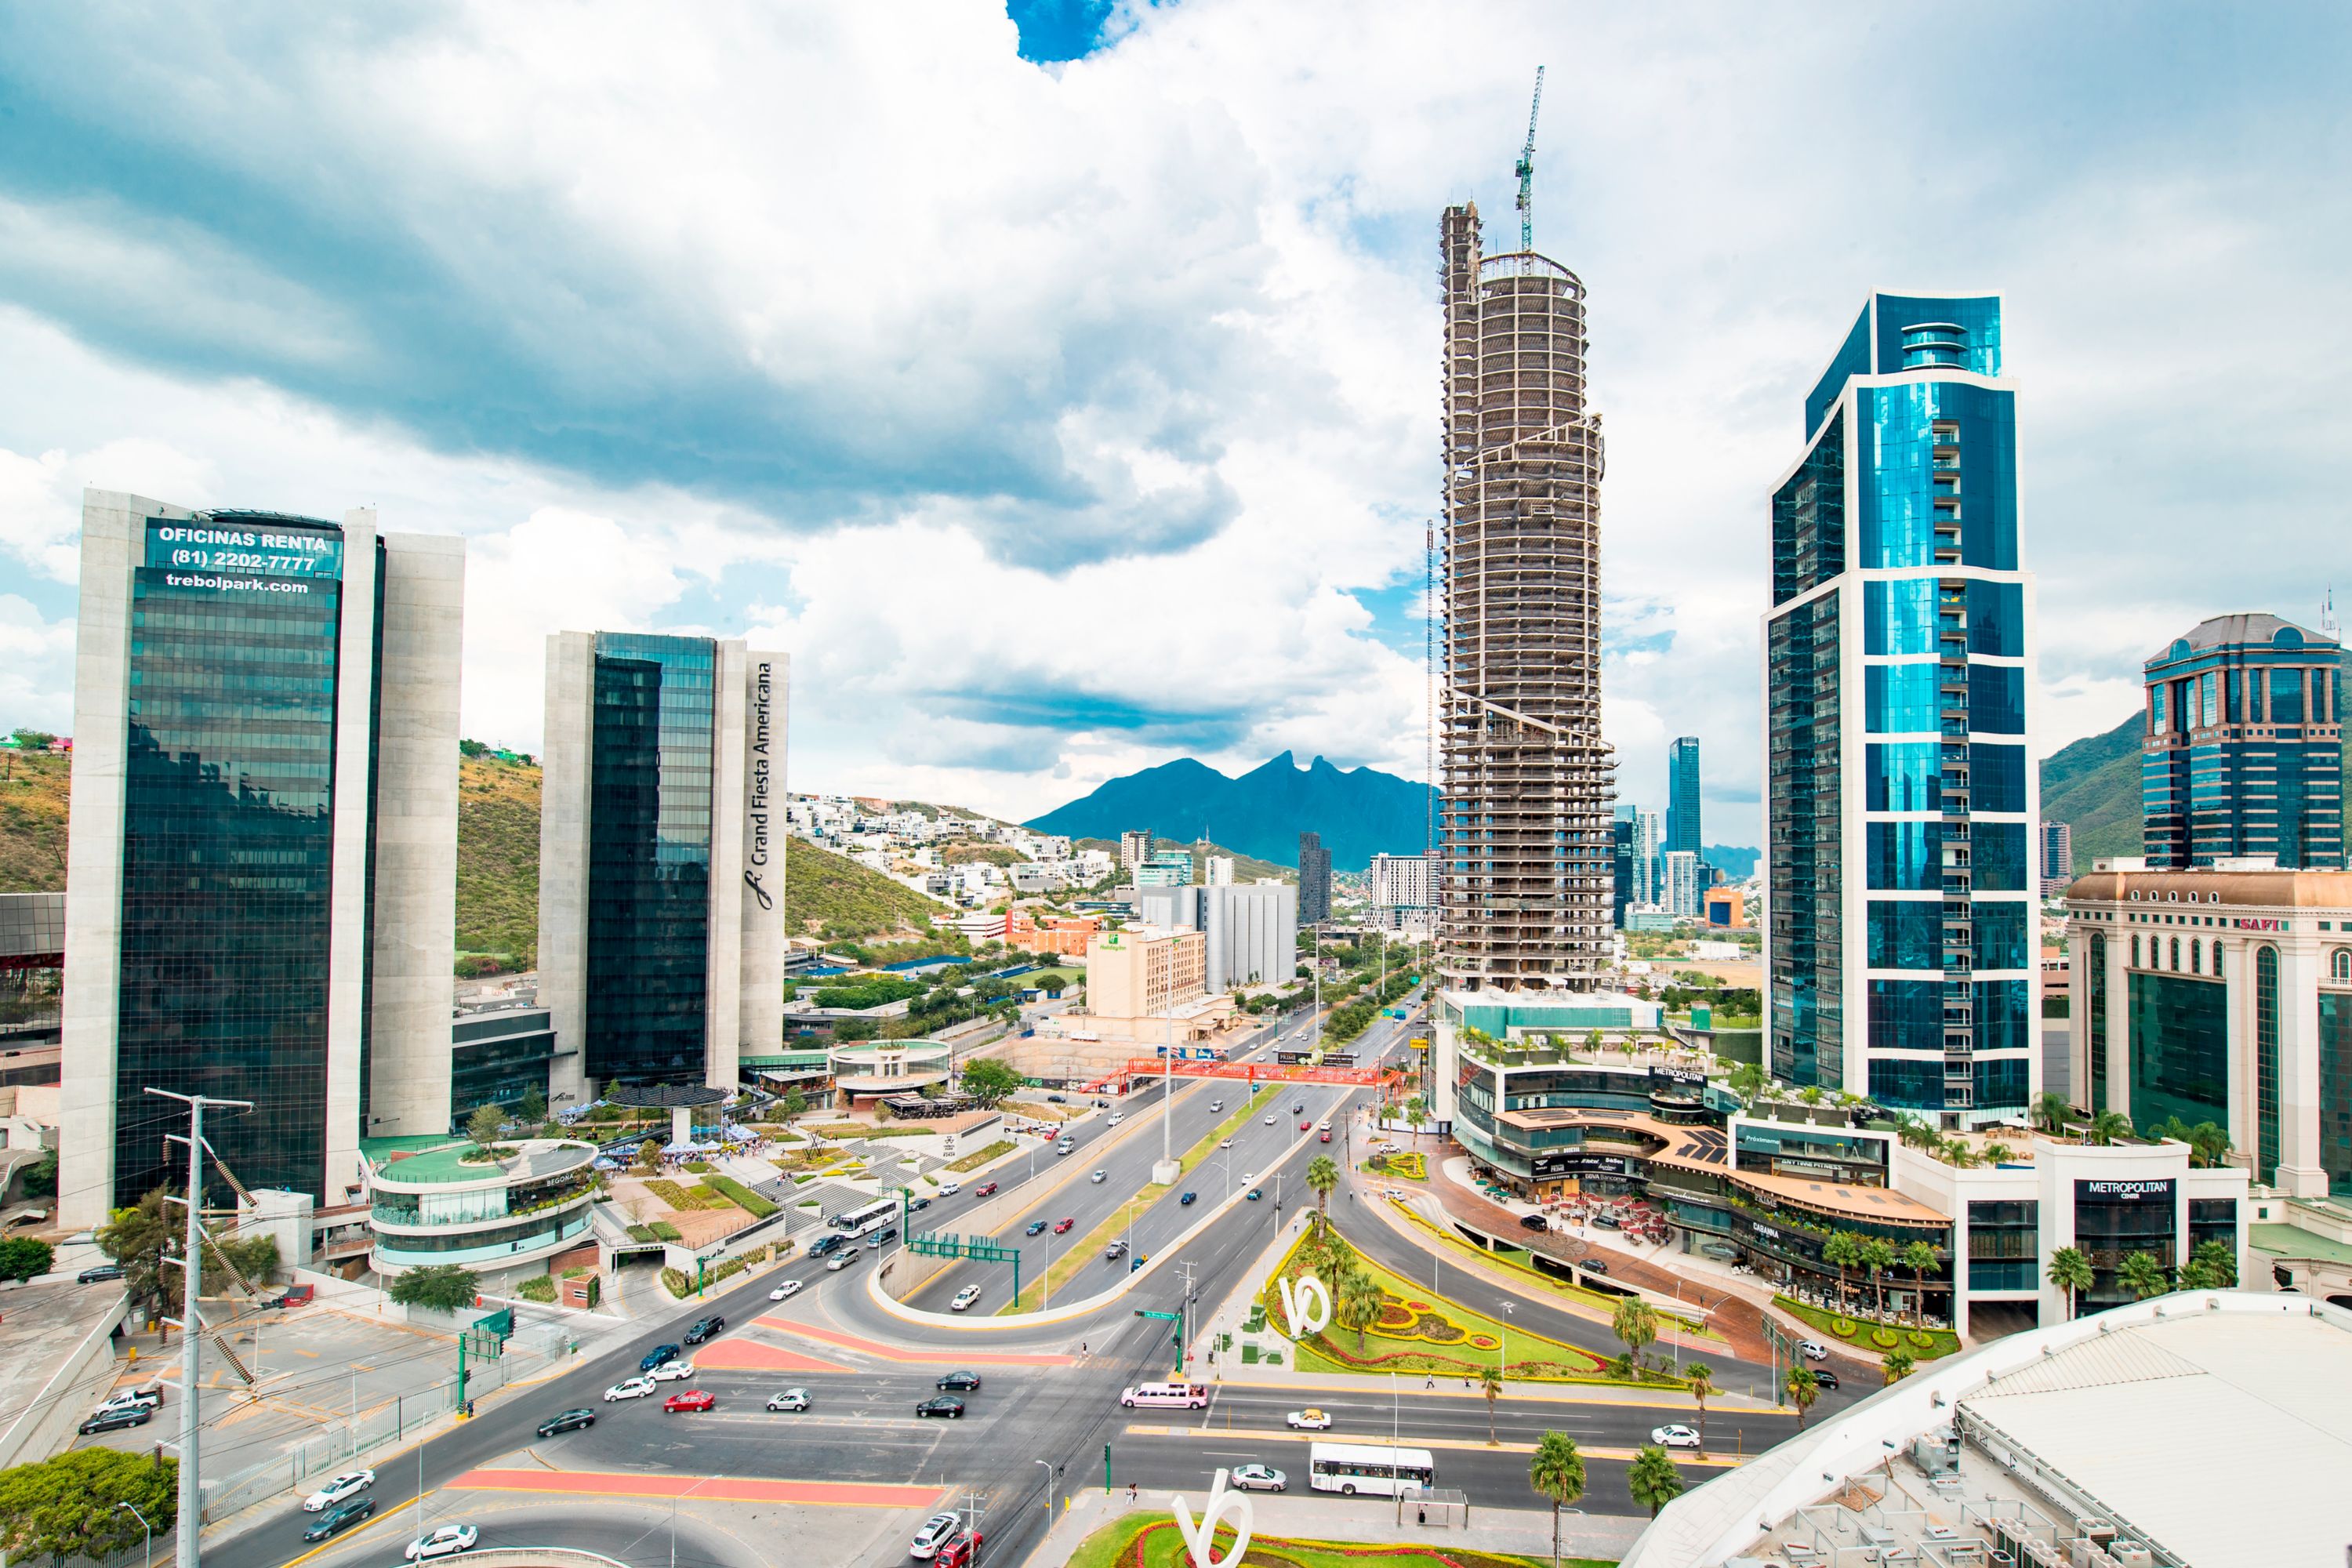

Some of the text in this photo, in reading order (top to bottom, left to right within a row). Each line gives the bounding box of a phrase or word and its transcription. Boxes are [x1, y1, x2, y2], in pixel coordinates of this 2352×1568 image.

[159, 527, 328, 551] OFICINAS RENTA
[172, 549, 315, 571] (81) 2202-7777
[166, 573, 309, 593] trebolpark.com
[753, 662, 771, 755] Americana
[751, 759, 769, 808] Fiesta
[750, 812, 768, 866] Grand
[2241, 919, 2279, 931] SAFI
[1654, 1067, 1704, 1082] METROPOLITAN
[546, 1173, 574, 1187] BEGOÑA
[2089, 1181, 2167, 1192] METROPOLITAN
[1755, 1192, 1777, 1208] PRIME
[1753, 1221, 1780, 1239] CABANNA
